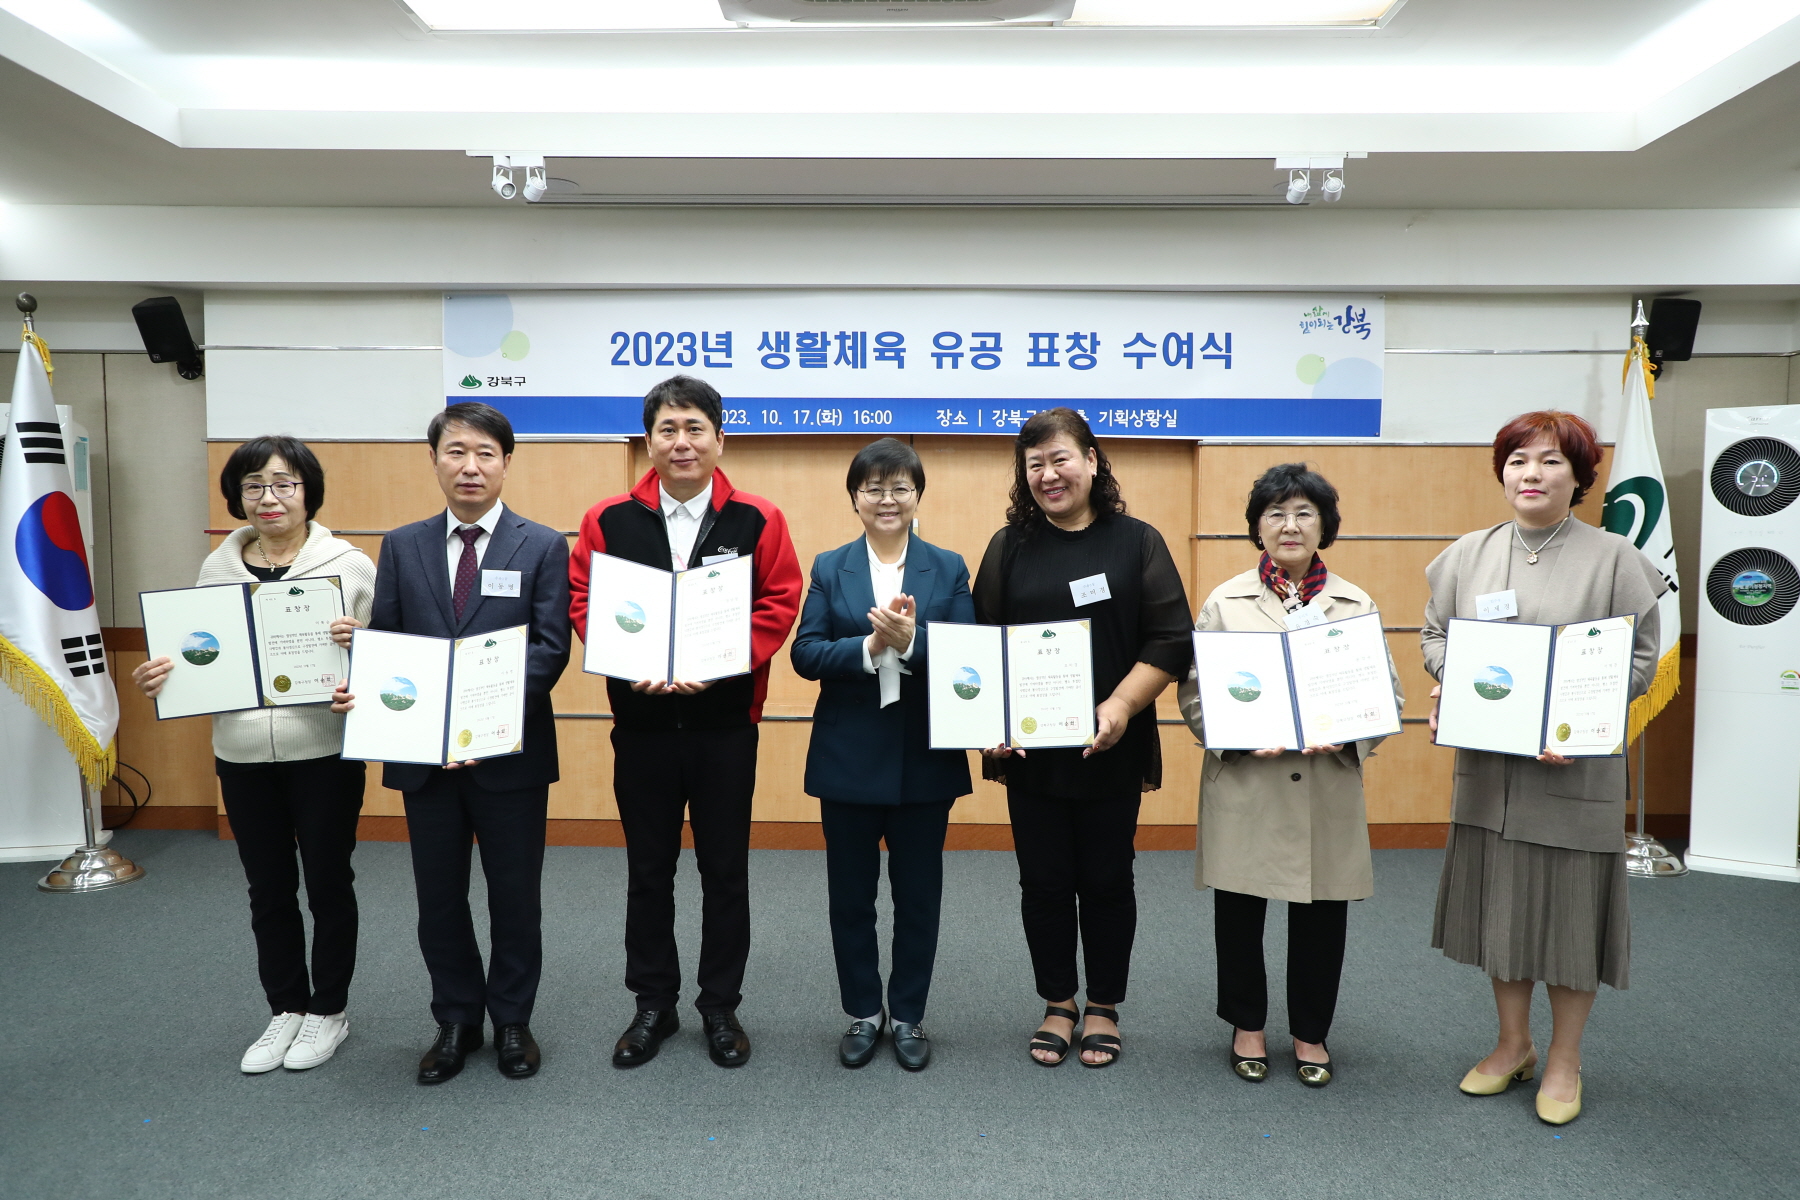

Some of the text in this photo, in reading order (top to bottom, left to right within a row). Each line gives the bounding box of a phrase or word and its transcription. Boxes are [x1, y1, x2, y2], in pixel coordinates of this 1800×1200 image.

[1333, 304, 1371, 340] 강북
[611, 330, 1232, 371] 2023년 생활체육 유공 표창 수여식
[487, 376, 527, 388] 강북구
[722, 409, 751, 426] 023.
[761, 409, 783, 426] 10.
[853, 409, 892, 425] 16:00
[935, 408, 969, 428] 장소
[1098, 409, 1178, 428] 기획상황실
